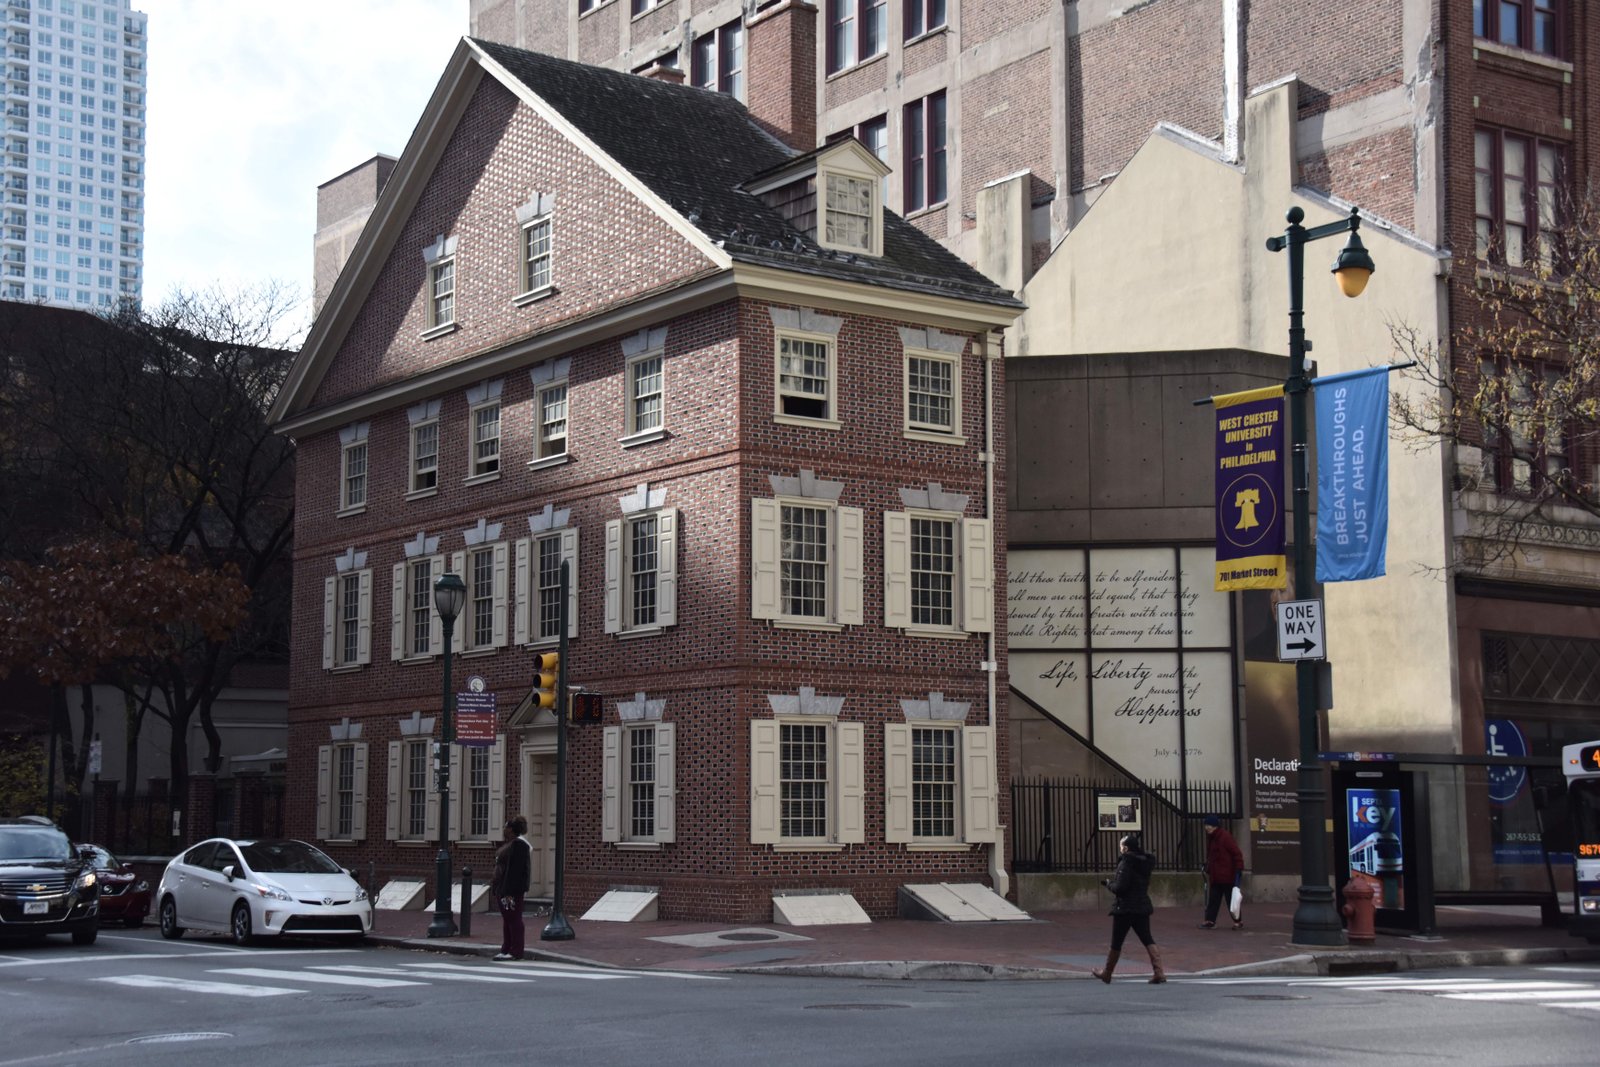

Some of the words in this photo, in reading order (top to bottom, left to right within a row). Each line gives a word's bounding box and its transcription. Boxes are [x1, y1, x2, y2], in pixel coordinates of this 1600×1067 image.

[1219, 416, 1242, 431] WEST
[1243, 410, 1279, 427] CHESTER
[1225, 425, 1273, 443] UNIVERSITY
[1220, 450, 1276, 469] PHILADELPHIA
[1333, 387, 1349, 545] BREAKTHROUGHS
[1352, 425, 1365, 491] AHEAD.
[1353, 498, 1369, 544] JUST
[1028, 571, 1054, 583] these
[1058, 571, 1088, 583] truth
[1095, 571, 1108, 582] to
[1109, 569, 1120, 582] be
[1219, 572, 1230, 582] 701
[1231, 570, 1252, 579] Market
[1253, 568, 1278, 577] Street
[1008, 589, 1027, 601] all
[1069, 588, 1107, 601] creted
[1141, 587, 1168, 600] that
[1041, 605, 1055, 625] by
[1059, 605, 1084, 618] their
[1130, 605, 1158, 618] with
[1160, 606, 1195, 618] cerain
[1285, 605, 1315, 620] ONE
[1039, 624, 1078, 644] Rights,
[1110, 629, 1144, 643] among
[1148, 623, 1174, 636] these
[1285, 620, 1316, 636] WAY
[1039, 659, 1077, 688] Life,
[1086, 659, 1152, 690] Liberty
[1157, 667, 1180, 678] and
[1187, 682, 1201, 700] of
[1115, 696, 1202, 725] Happinss
[1254, 757, 1302, 772] Declarati
[1255, 772, 1286, 785] House
